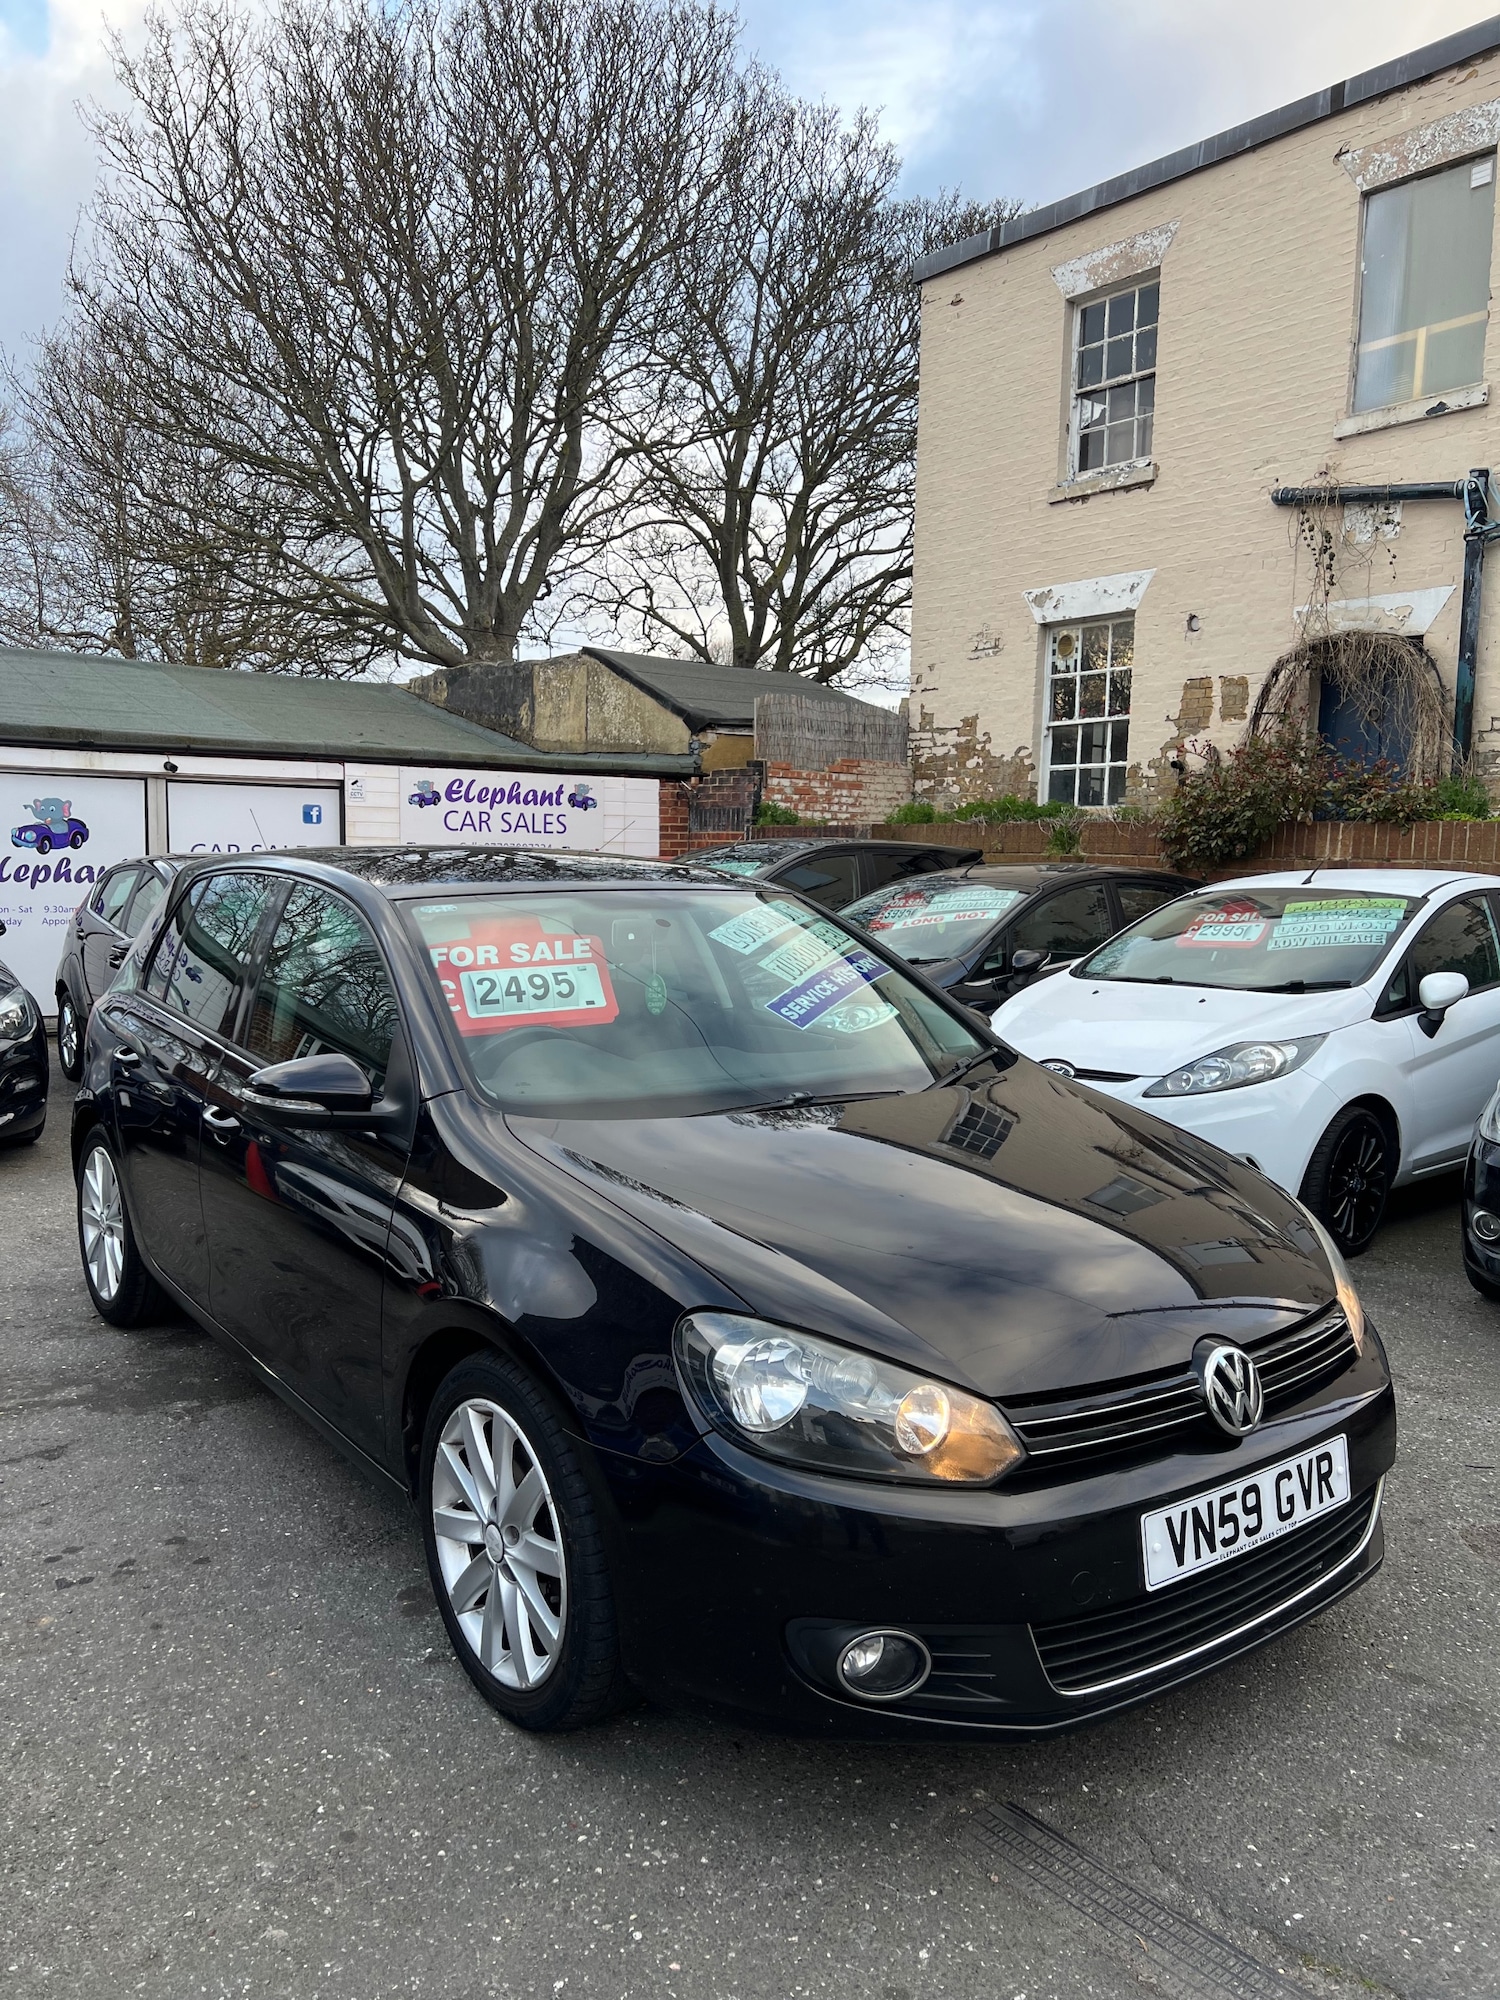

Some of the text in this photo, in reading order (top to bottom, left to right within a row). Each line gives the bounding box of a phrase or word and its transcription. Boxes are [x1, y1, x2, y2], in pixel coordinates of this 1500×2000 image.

[444, 778, 564, 811] Elephant
[443, 810, 567, 835] CAR SALES
[18, 905, 33, 913] Sat
[902, 917, 945, 927] LONG
[953, 911, 990, 921] MOT
[1194, 913, 1226, 922] FOR
[1270, 934, 1384, 948] LOW MILEAGE
[1276, 922, 1329, 934] LONG
[430, 938, 592, 968] FOR SALE
[475, 971, 576, 1006] 2495
[779, 956, 880, 1020] SERVICE HISTORY
[1164, 1451, 1336, 1568] VN59 GVR
[1219, 1544, 1247, 1560] ELEPHANT
[1247, 1538, 1259, 1548] CAR
[1259, 1531, 1275, 1541] SALES
